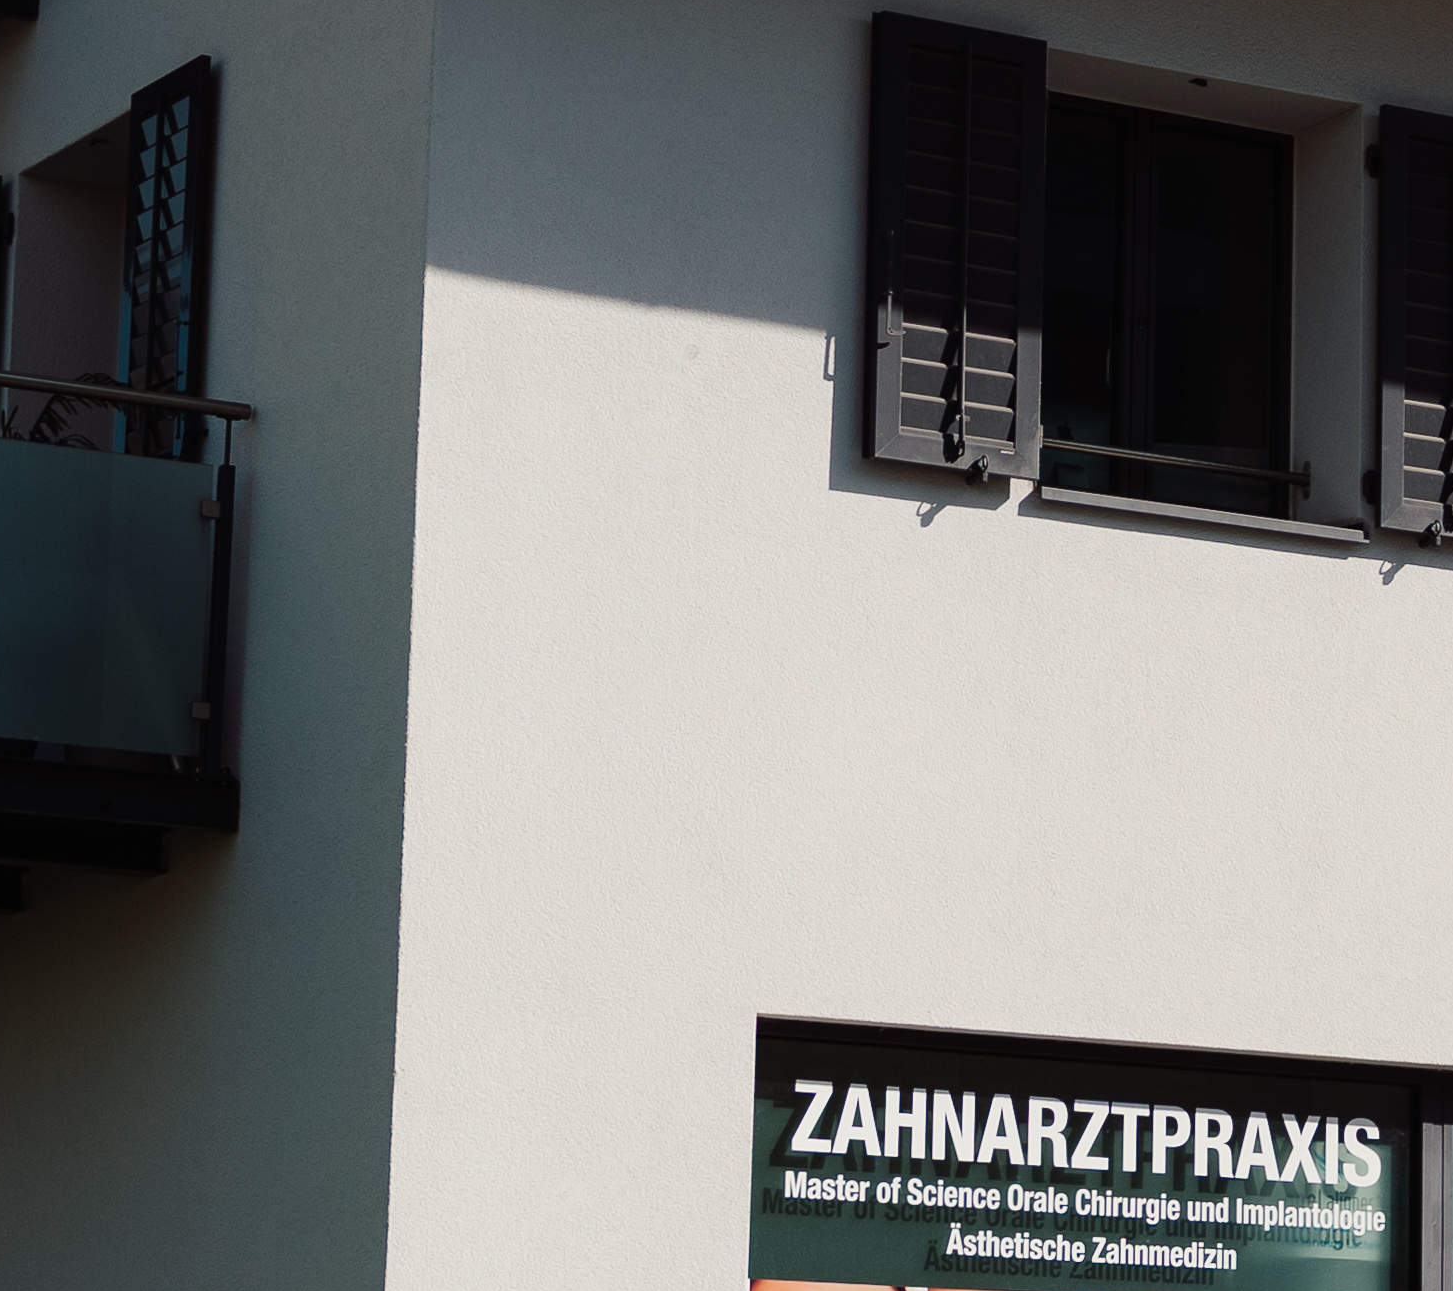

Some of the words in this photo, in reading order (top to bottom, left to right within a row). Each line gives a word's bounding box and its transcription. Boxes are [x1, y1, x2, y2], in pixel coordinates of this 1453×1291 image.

[791, 1079, 1382, 1188] ZAHNARZTPRAXIS
[784, 1170, 870, 1202] Master
[876, 1177, 902, 1205] of
[906, 1178, 1001, 1210] Science
[1007, 1184, 1069, 1215] Orale
[1075, 1187, 1181, 1226] Chirurgie
[1187, 1197, 1230, 1225] und
[1236, 1197, 1386, 1236] Implantologie
[946, 1222, 1085, 1263] Ästhetische
[1091, 1236, 1238, 1271] Zahnmedizin
